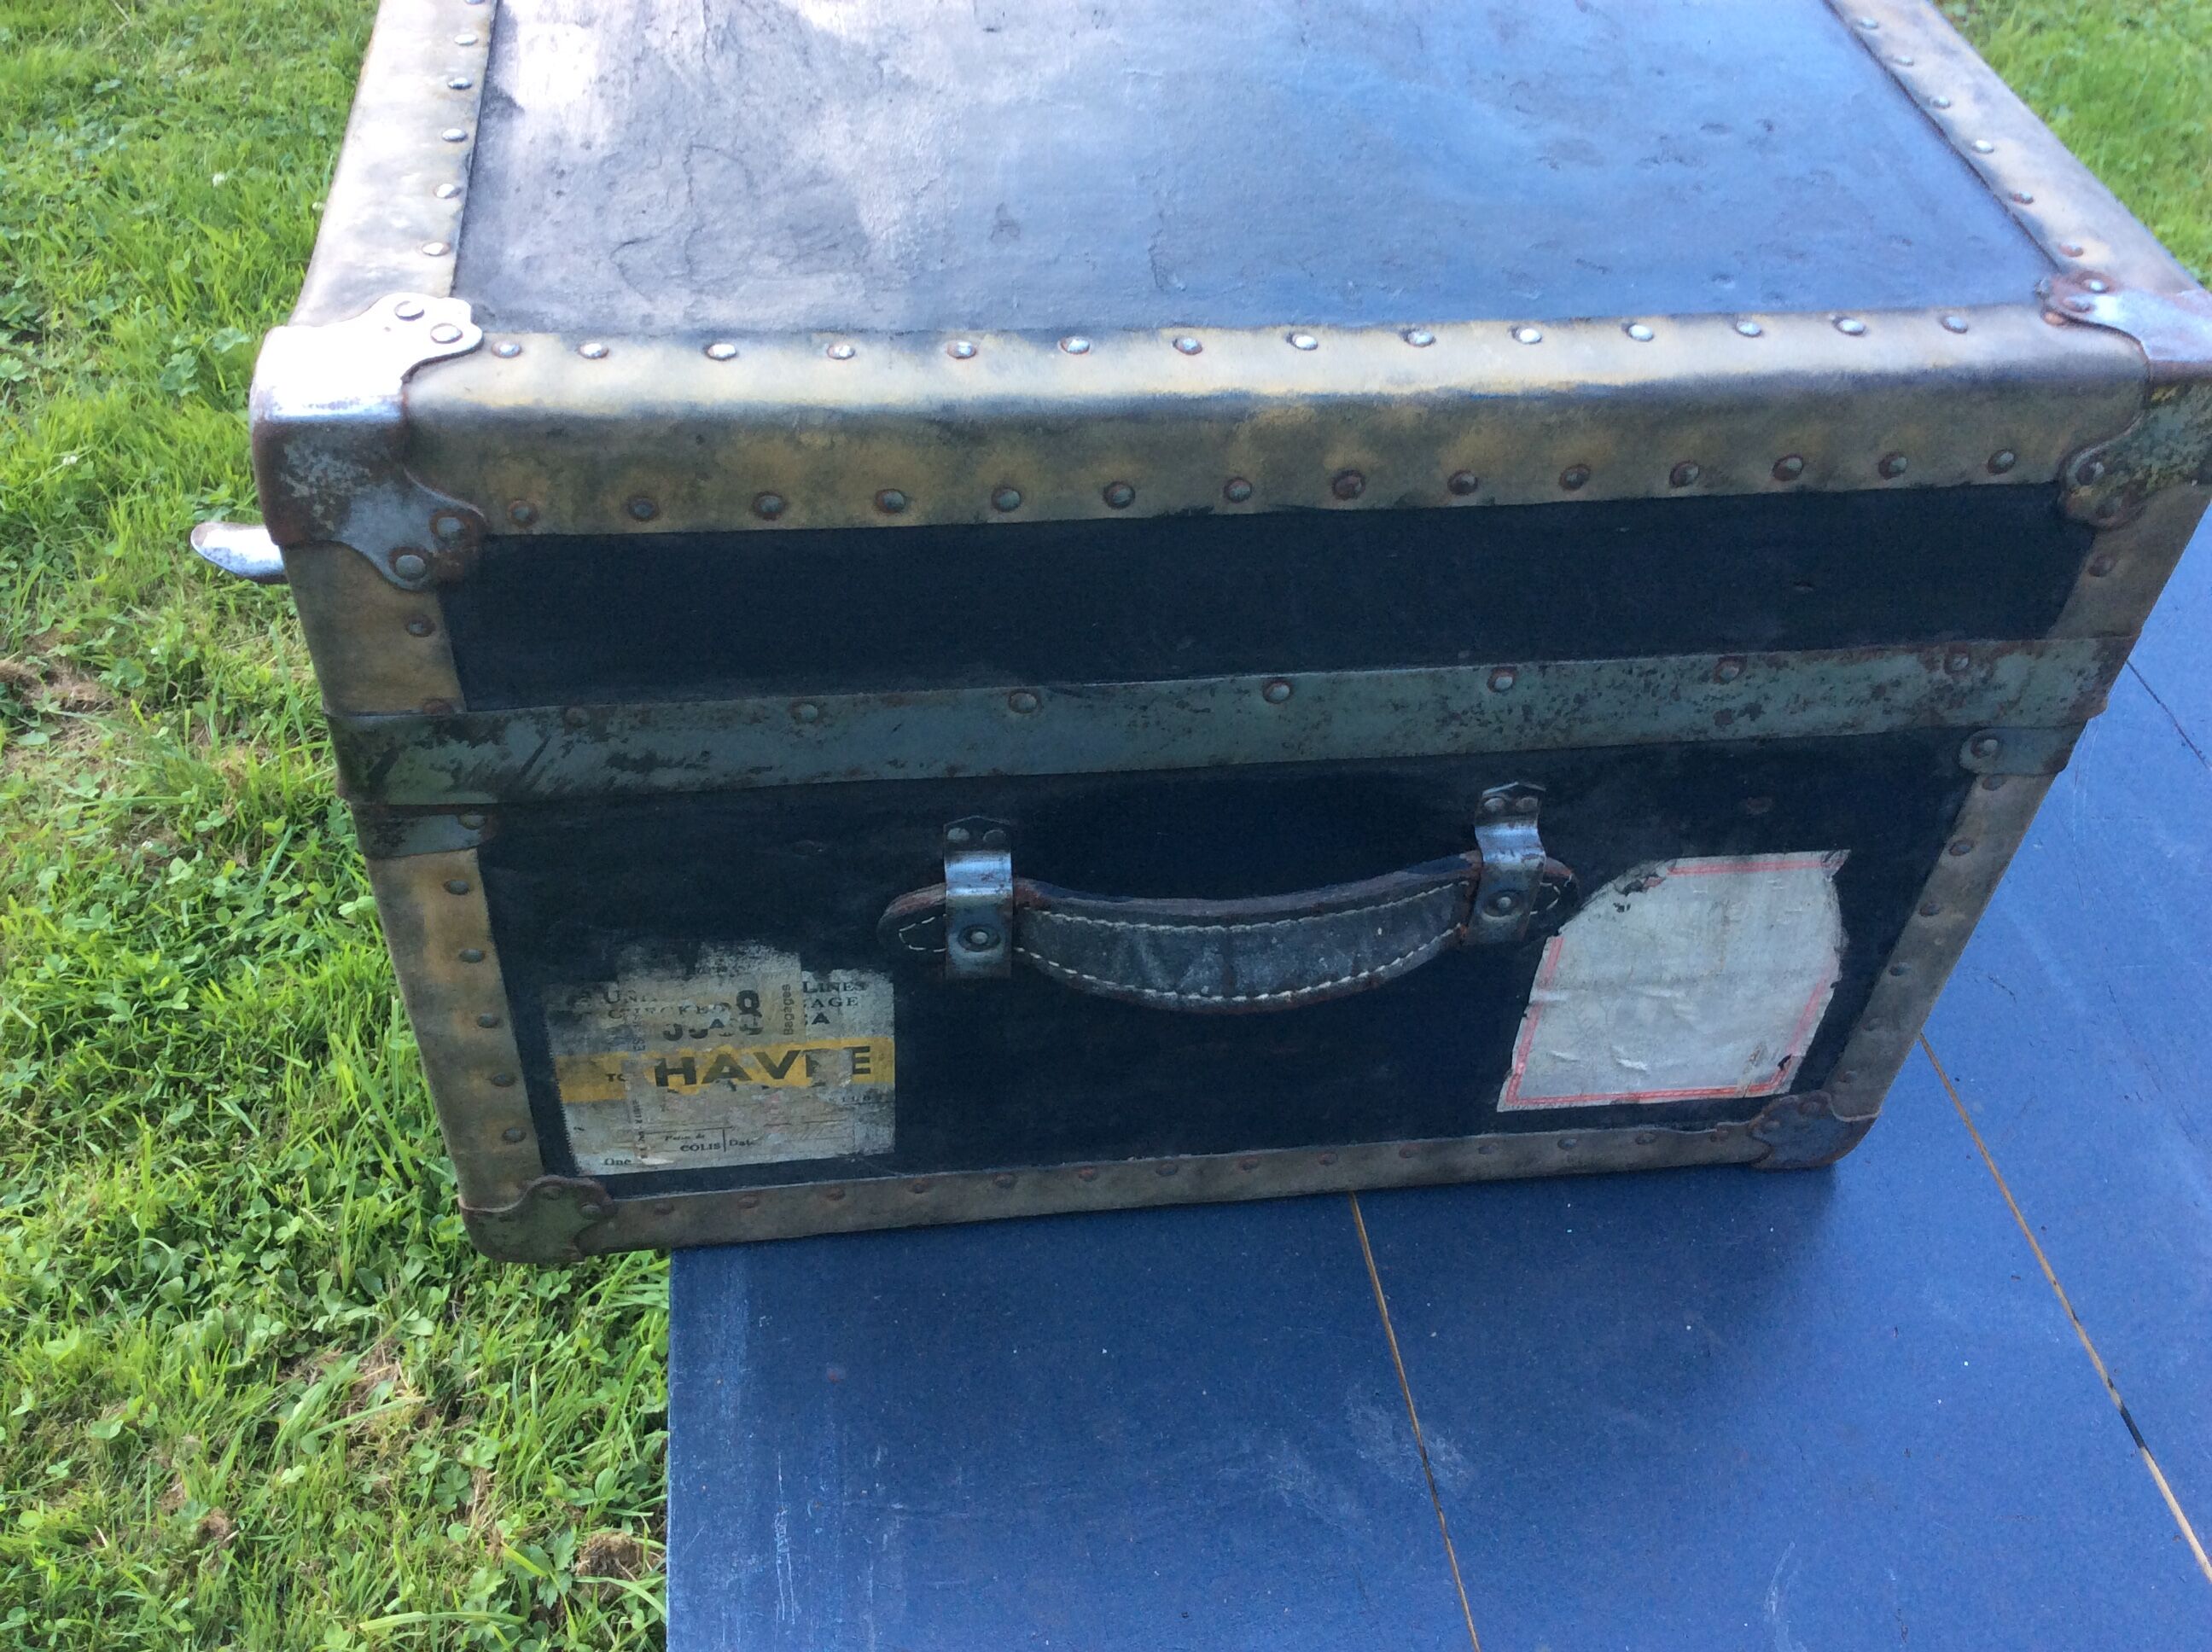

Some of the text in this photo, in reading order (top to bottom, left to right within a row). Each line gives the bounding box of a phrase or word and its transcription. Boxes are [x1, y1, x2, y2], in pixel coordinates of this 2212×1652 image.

[803, 996, 860, 1009] AGE
[782, 983, 795, 1035] Bagages
[679, 1142, 722, 1153] COLIS
[604, 1157, 632, 1166] One
